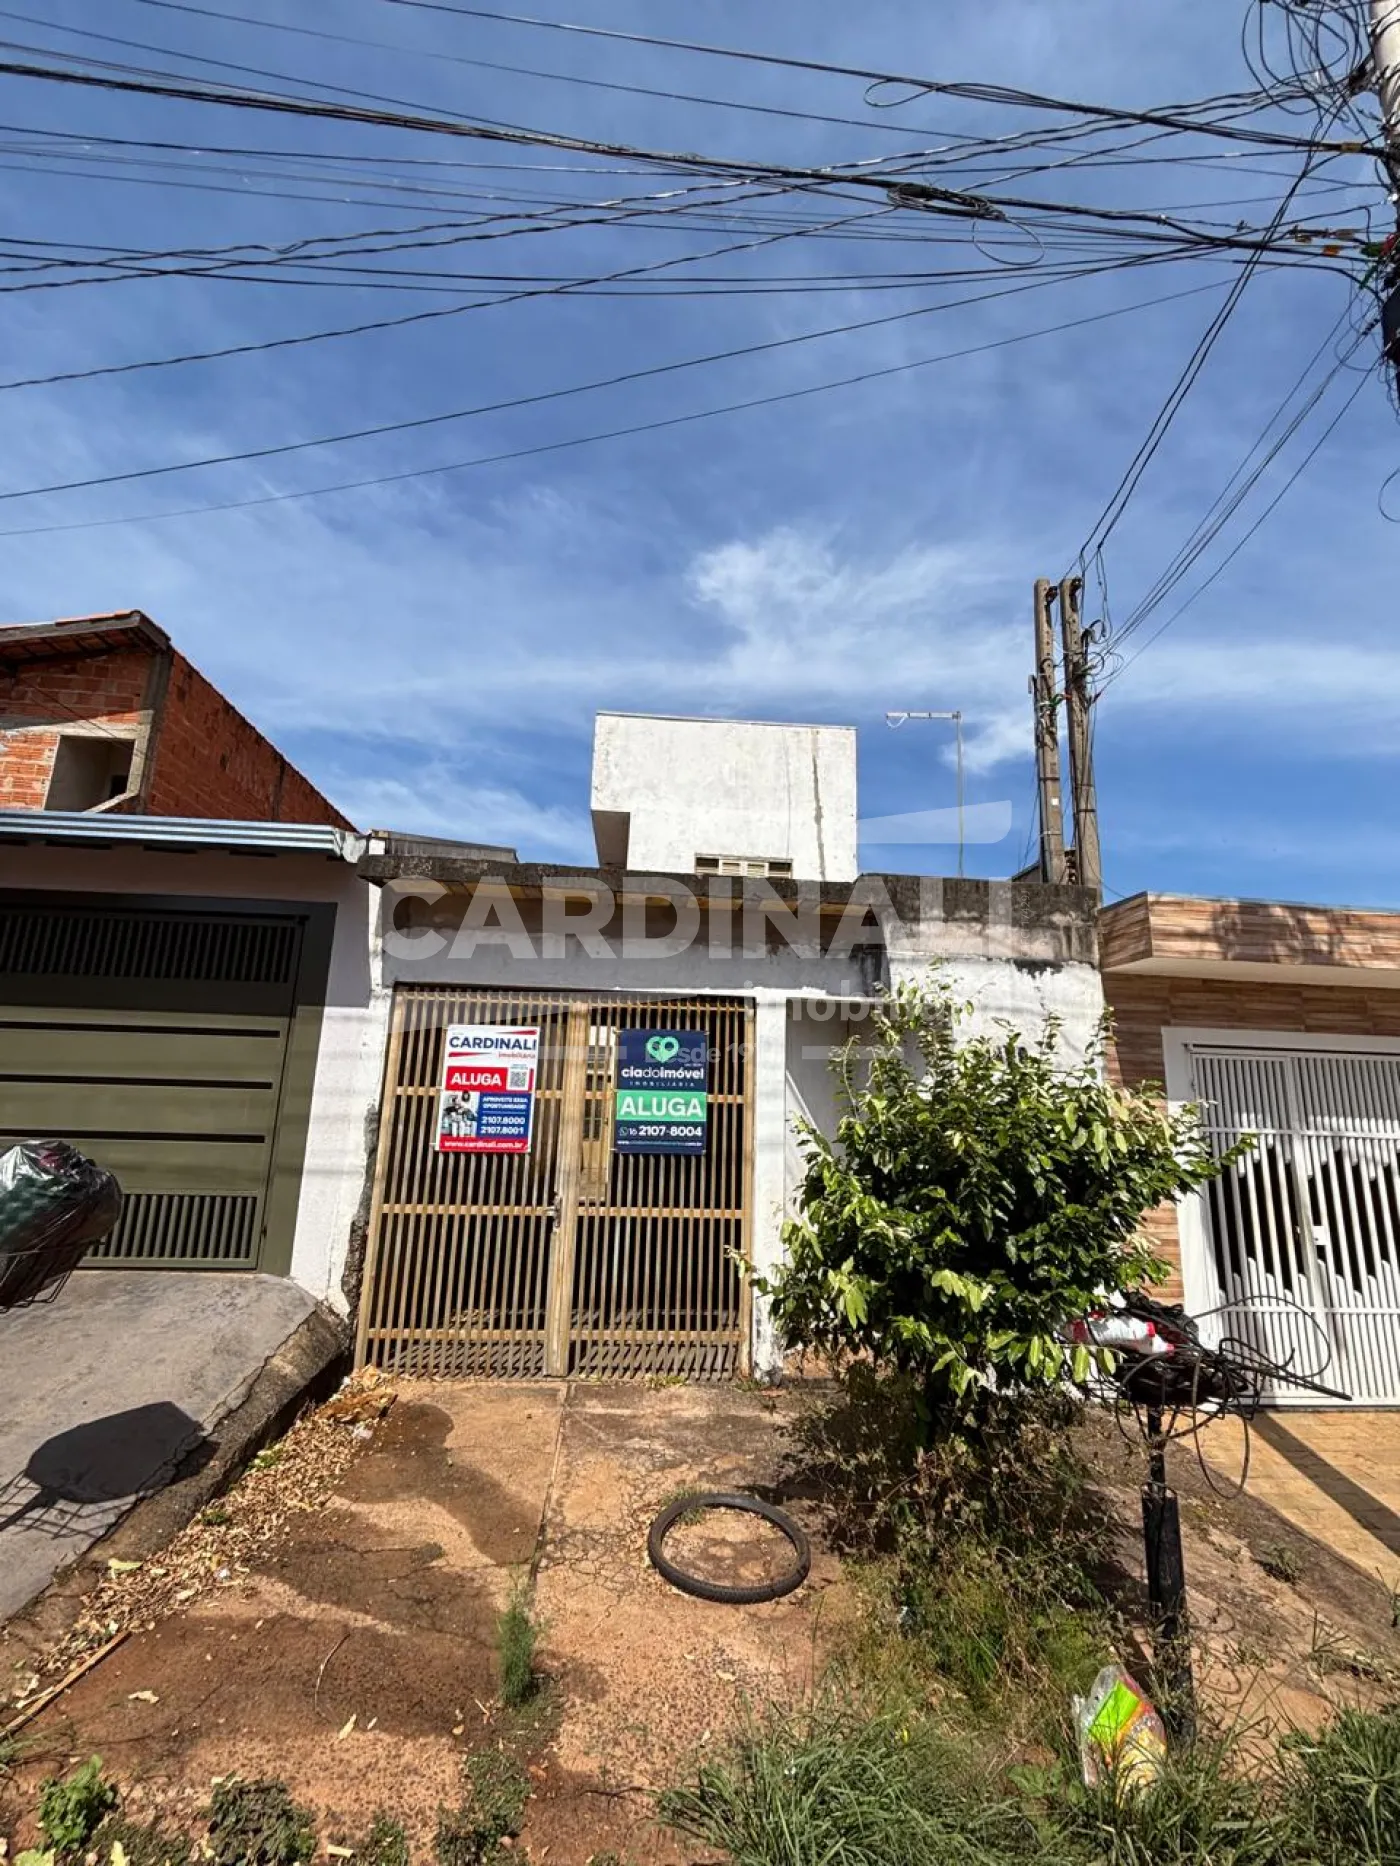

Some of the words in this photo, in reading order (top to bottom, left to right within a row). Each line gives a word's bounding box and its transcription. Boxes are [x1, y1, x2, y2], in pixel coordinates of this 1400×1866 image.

[449, 1036, 537, 1051] CARDINALI
[621, 1065, 704, 1079] ciadoimóvel
[451, 1072, 502, 1086] ALUGA
[621, 1096, 703, 1117] ALUGA
[481, 1116, 526, 1125] 2107.8000
[480, 1126, 525, 1135] 2107.8001
[639, 1125, 702, 1136] 2107-8004
[444, 1140, 525, 1149] www.cardinali.com.br
